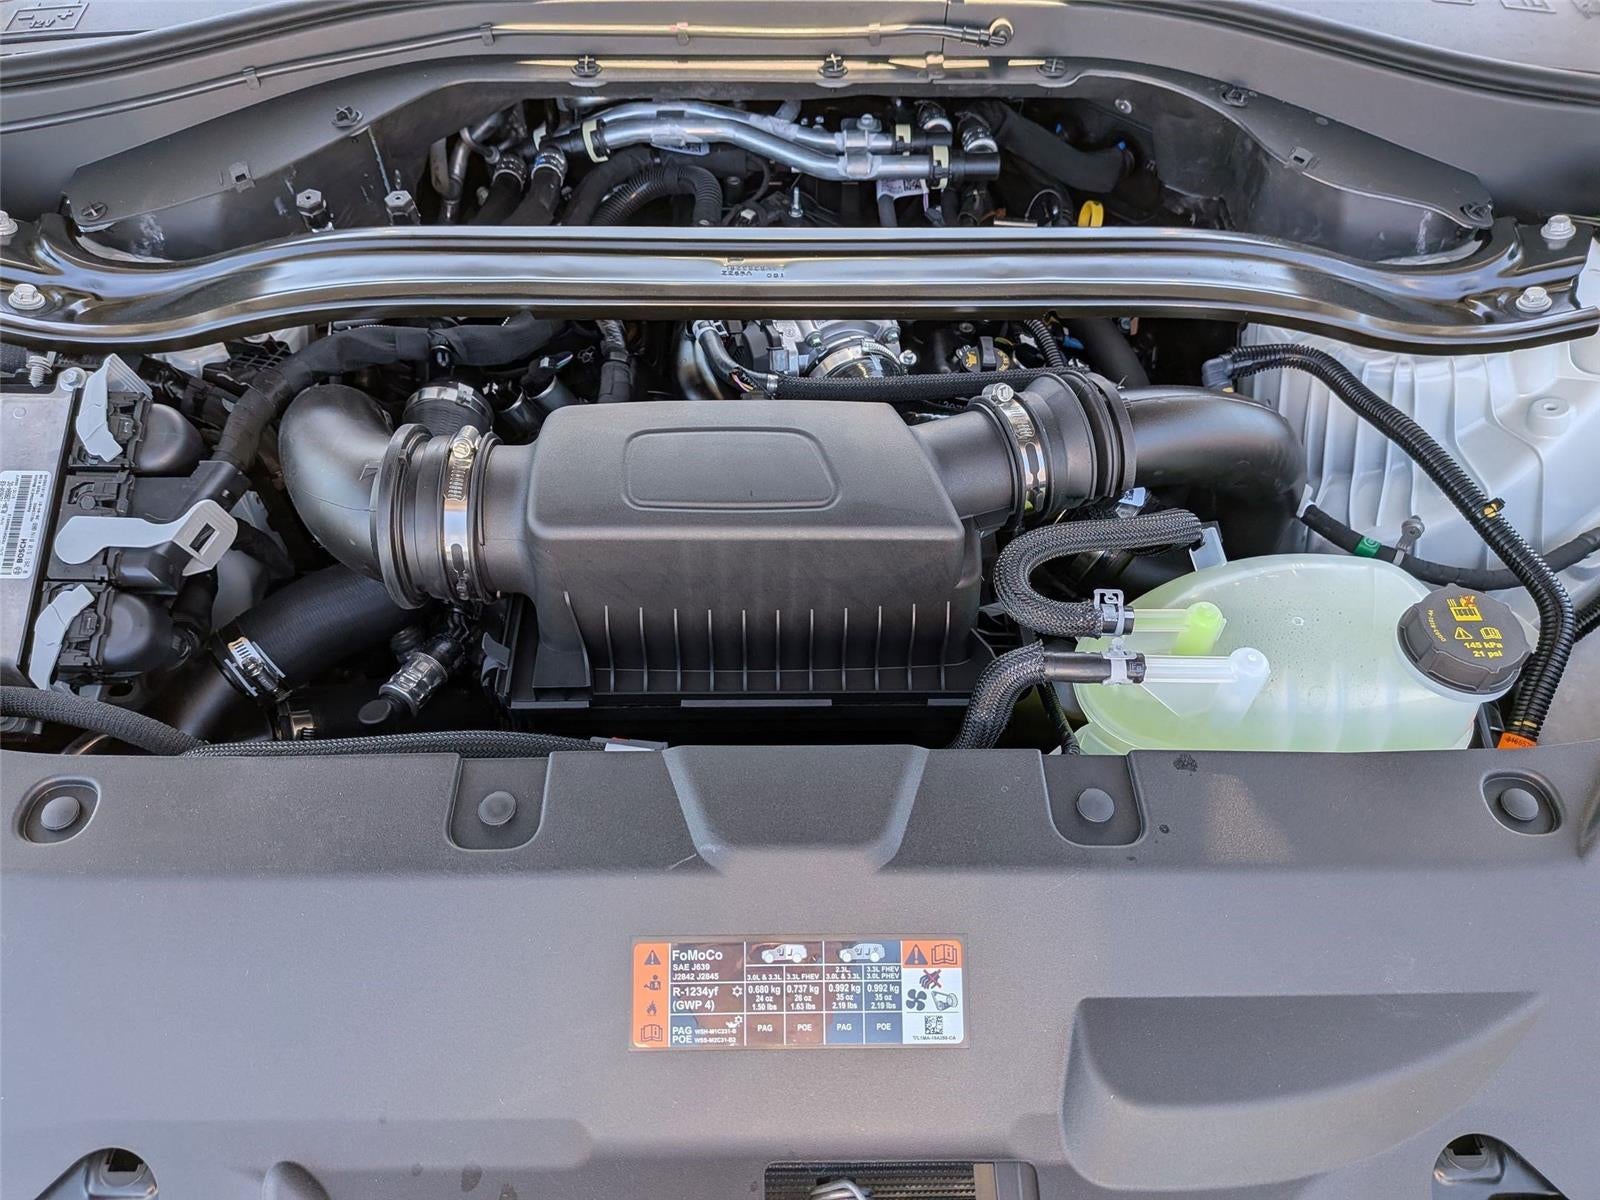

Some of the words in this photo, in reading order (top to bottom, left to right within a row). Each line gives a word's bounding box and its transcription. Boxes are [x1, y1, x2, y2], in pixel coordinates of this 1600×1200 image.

[16, 539, 27, 564] BOSCH
[1488, 650, 1502, 658] psi
[672, 949, 723, 960] FoMoCo
[672, 986, 719, 998] R-1234yf
[748, 985, 769, 994] 0.680
[770, 985, 781, 995] kg
[787, 984, 807, 993] 0.737
[810, 984, 820, 995] kg
[828, 984, 849, 992] 0.992
[851, 984, 861, 994] kg
[867, 984, 888, 992] 0.992
[889, 984, 899, 994] kg
[672, 1000, 702, 1012] (GWP
[705, 1000, 714, 1011] 4)
[672, 1026, 692, 1034] PAG
